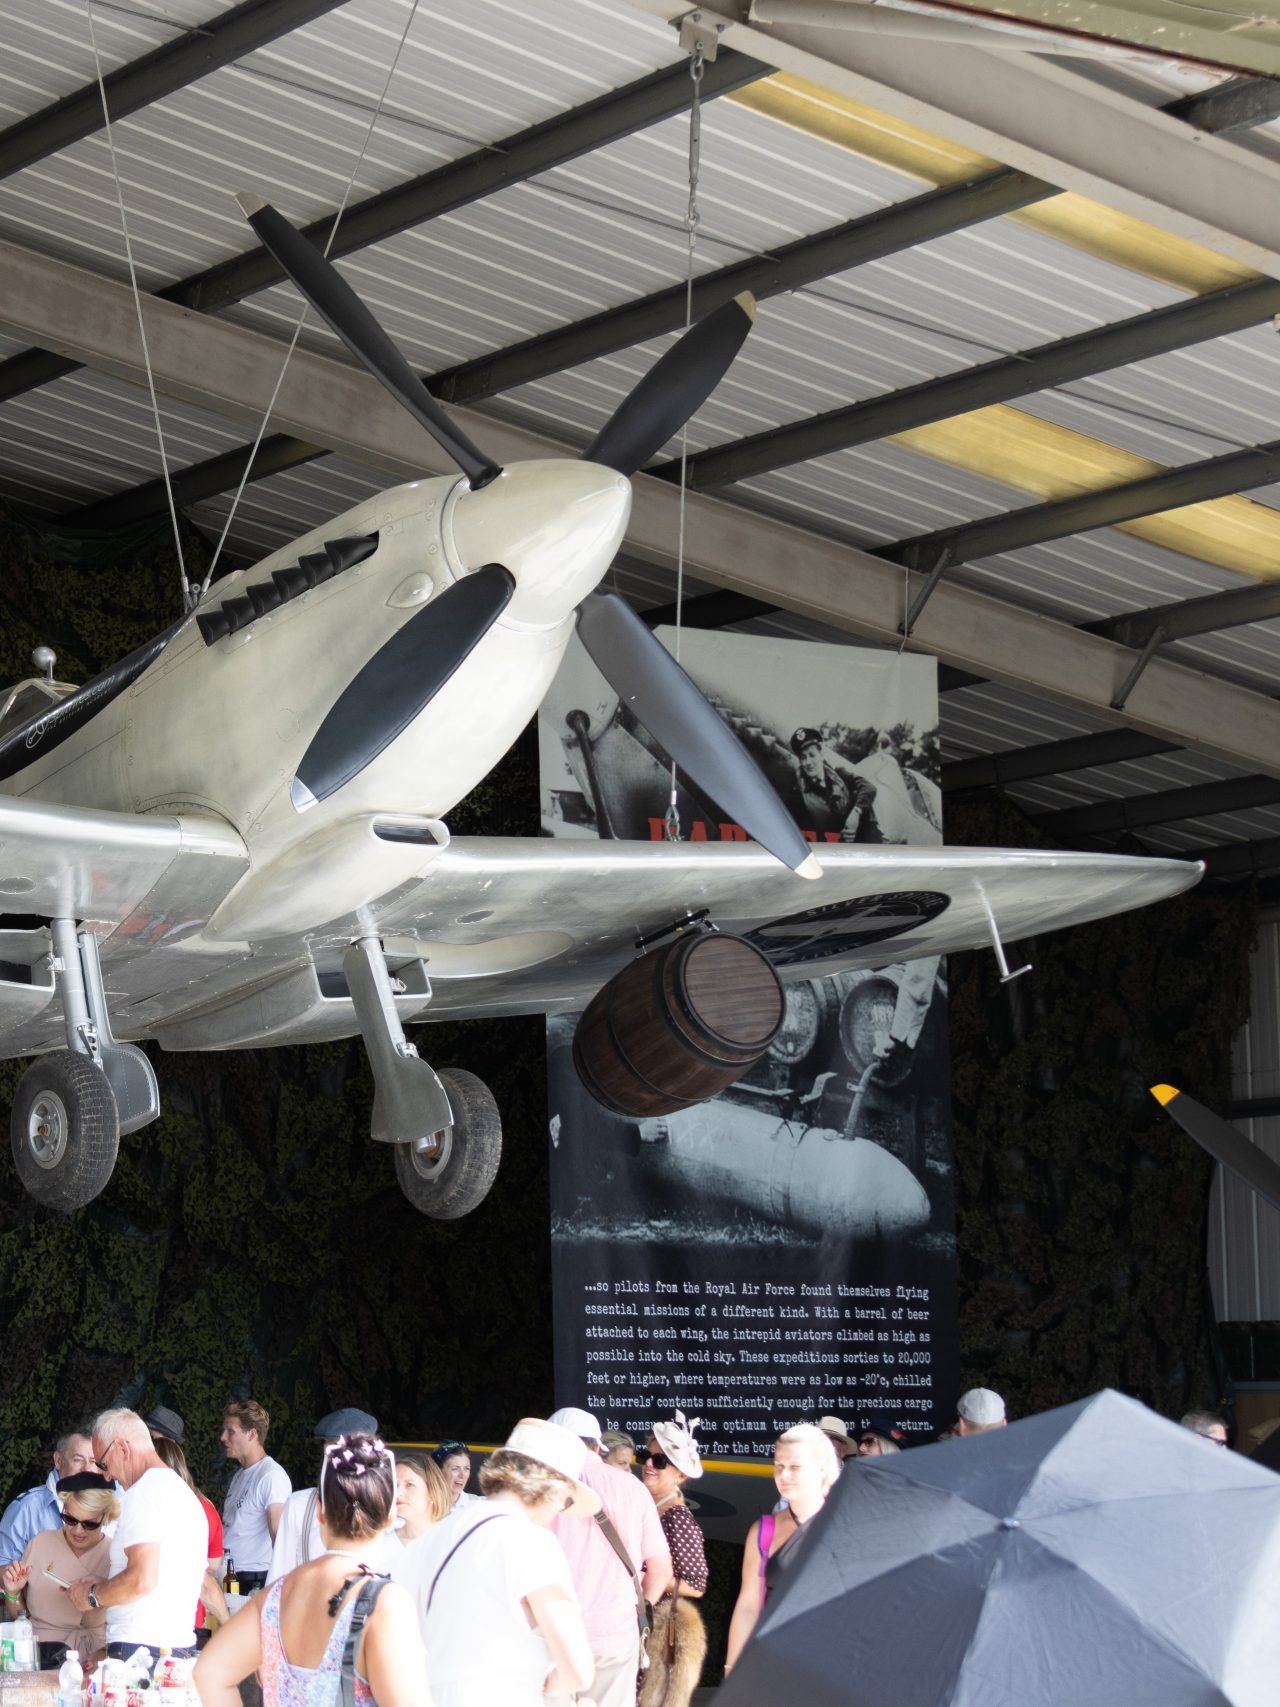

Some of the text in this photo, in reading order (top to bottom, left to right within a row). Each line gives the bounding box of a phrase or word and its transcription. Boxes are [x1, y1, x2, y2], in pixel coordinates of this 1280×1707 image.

[613, 1279, 650, 1295] pilots
[655, 1280, 679, 1294] from
[682, 1281, 701, 1294] the
[704, 1281, 737, 1298] Royal
[741, 1282, 761, 1295] Air
[764, 1282, 796, 1296] Force
[800, 1283, 833, 1297] found
[836, 1284, 892, 1298] themselves
[895, 1285, 930, 1302] flying
[584, 1302, 931, 1321] essential missions of a different kind. With a barrel of beer
[585, 1324, 931, 1345] attached to each wing, the intrepid aviators climbed as high as
[585, 1348, 932, 1367] possible into the cold sky. These expeditious sorties to 20,000
[586, 1371, 611, 1385] feet
[613, 1374, 627, 1385] or
[629, 1371, 671, 1388] higher,
[673, 1371, 705, 1385] where
[706, 1372, 778, 1389] temperatures
[780, 1375, 806, 1386] were
[809, 1375, 822, 1386] as
[823, 1373, 844, 1386] low
[845, 1375, 858, 1386] as
[892, 1373, 933, 1387] chilled
[587, 1394, 607, 1408] the
[656, 1395, 705, 1409] contents
[706, 1395, 775, 1412] sufficiently
[776, 1395, 816, 1411] enough
[817, 1395, 836, 1408] for
[837, 1395, 855, 1409] the
[856, 1396, 903, 1411] precious
[904, 1398, 934, 1412] cargo
[606, 1418, 620, 1431] be
[700, 1418, 718, 1431] the
[723, 1420, 767, 1434] optimum
[712, 1441, 729, 1454] for
[732, 1441, 751, 1454] the
